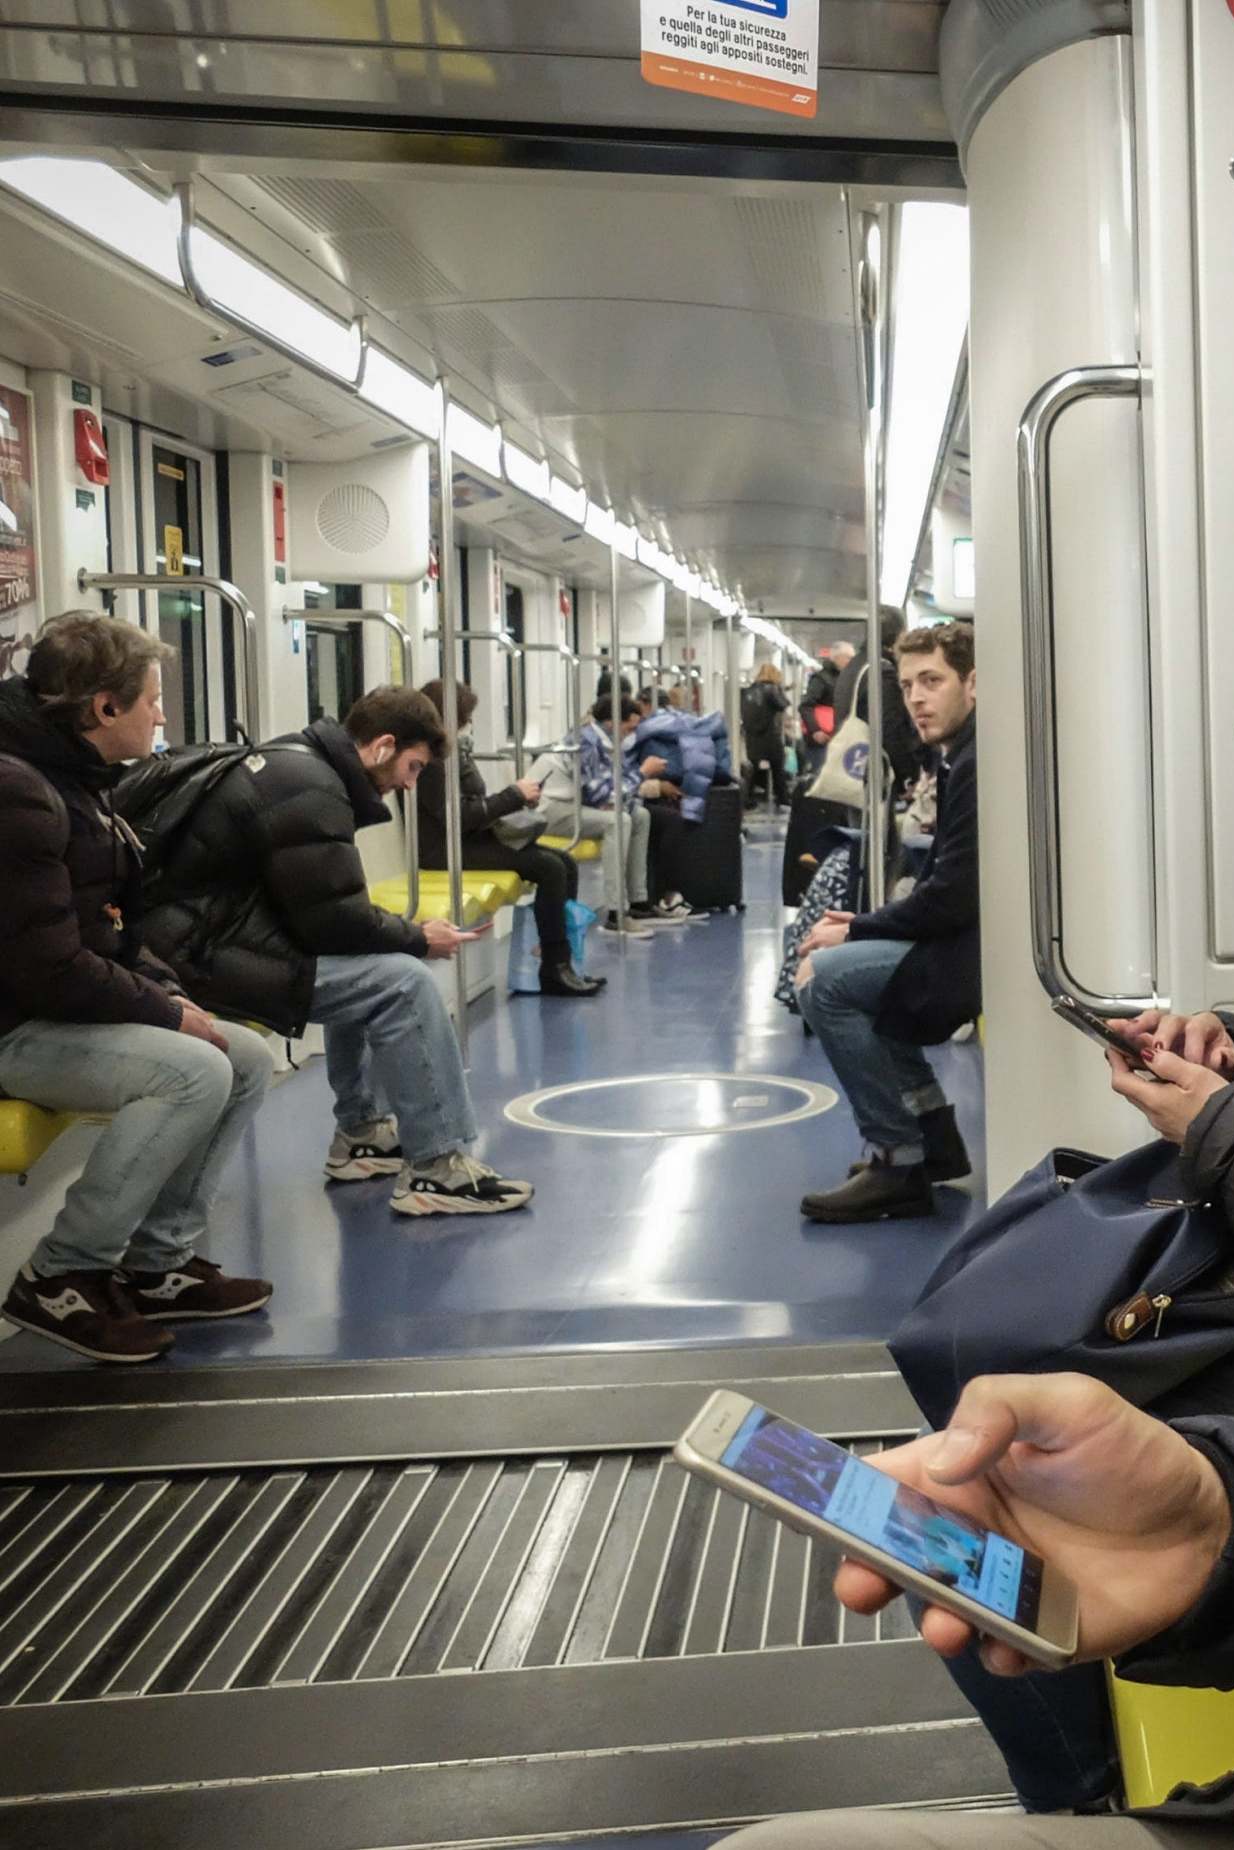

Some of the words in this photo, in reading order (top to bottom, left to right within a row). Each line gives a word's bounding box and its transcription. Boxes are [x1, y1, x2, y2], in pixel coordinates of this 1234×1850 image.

[659, 16, 667, 26] e
[669, 16, 703, 35] quella
[705, 23, 732, 42] degli
[734, 29, 754, 47] altri
[756, 37, 810, 62] passeggeri
[687, 5, 705, 20] Per
[708, 9, 717, 24] la
[720, 14, 737, 28] tua
[739, 19, 787, 41] sicurezza
[661, 30, 698, 49] reggiti
[700, 37, 720, 55] agli
[721, 43, 763, 65] appositi
[765, 53, 808, 75] sostegni.
